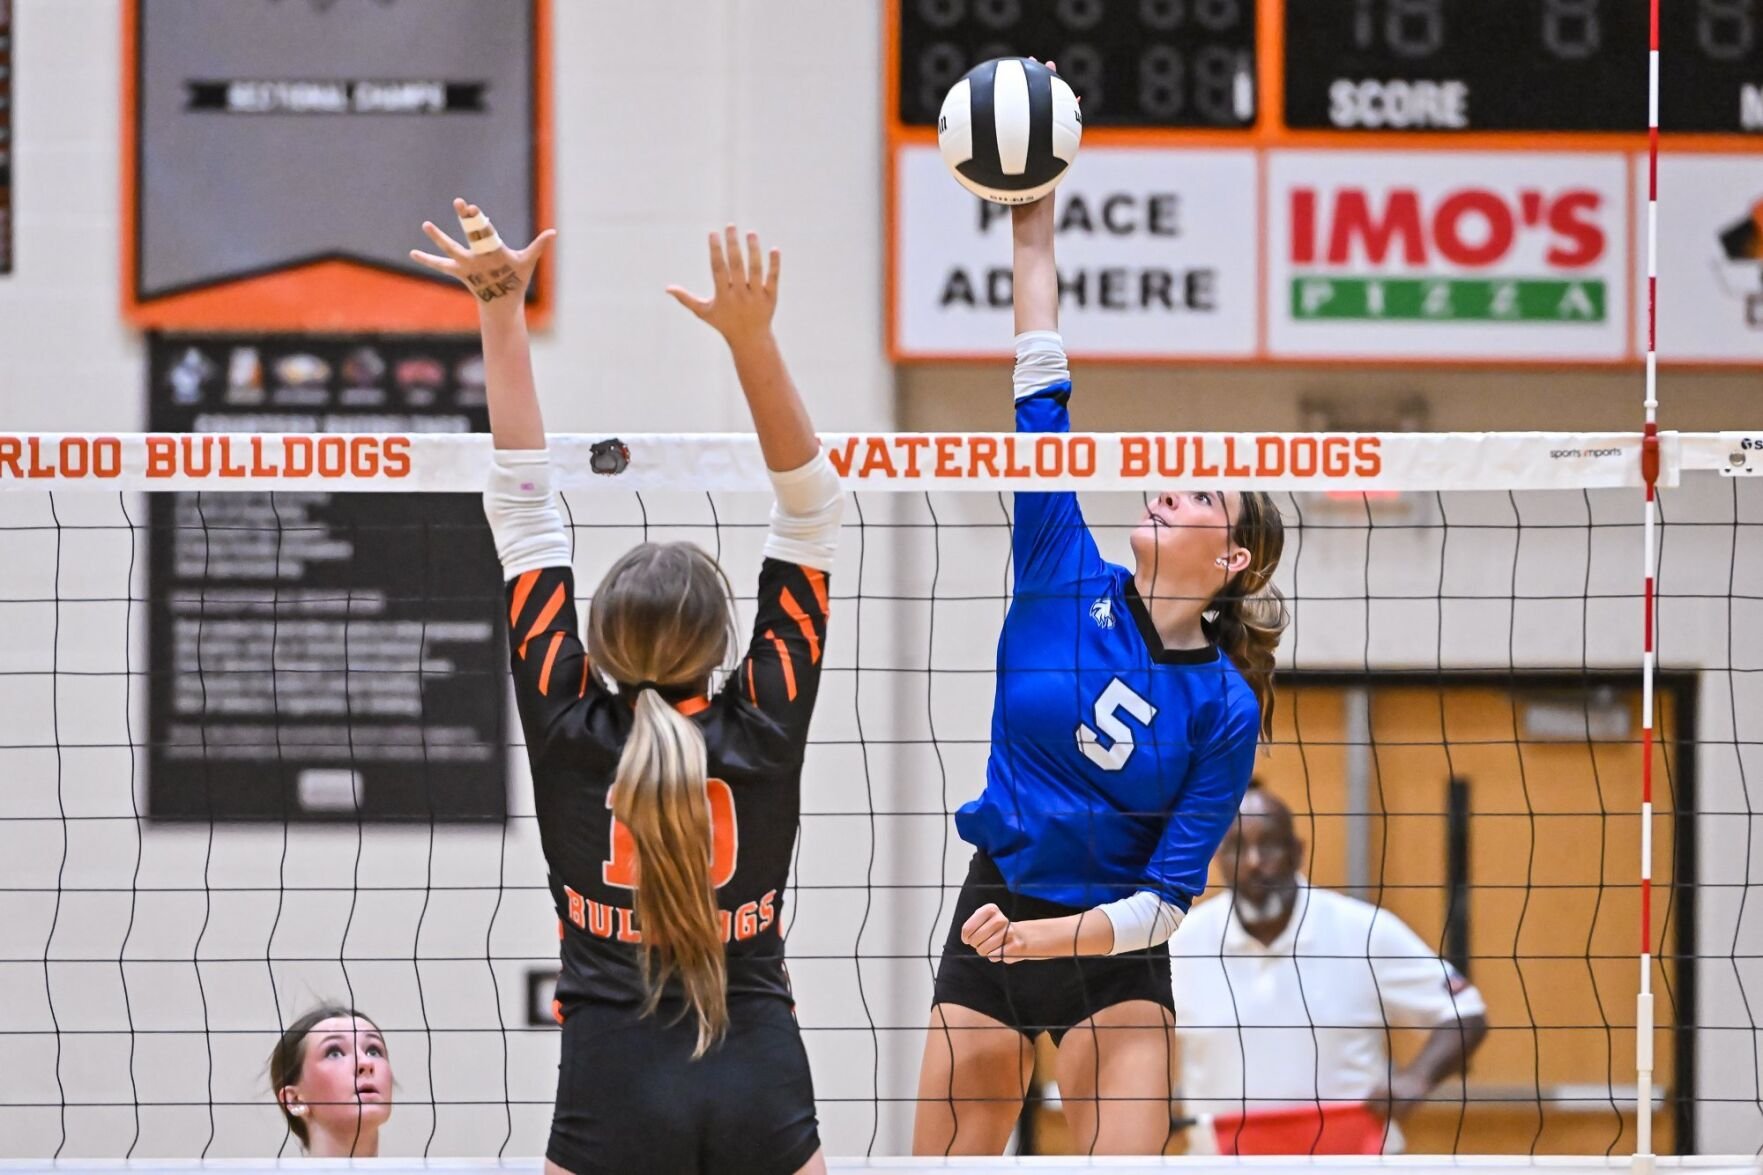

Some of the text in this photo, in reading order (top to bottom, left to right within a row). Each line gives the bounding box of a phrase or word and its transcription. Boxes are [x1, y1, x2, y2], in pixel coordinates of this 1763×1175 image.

[1329, 79, 1468, 127] SCORE
[977, 194, 1178, 236] PACE
[1290, 188, 1606, 268] IMO'S
[1301, 279, 1596, 315] PIZZA
[146, 436, 412, 478] BULLDOGS
[1120, 436, 1382, 478] BULLDOGS
[1550, 449, 1581, 459] sports
[1075, 677, 1158, 770] 5
[563, 885, 777, 943] BULGS
